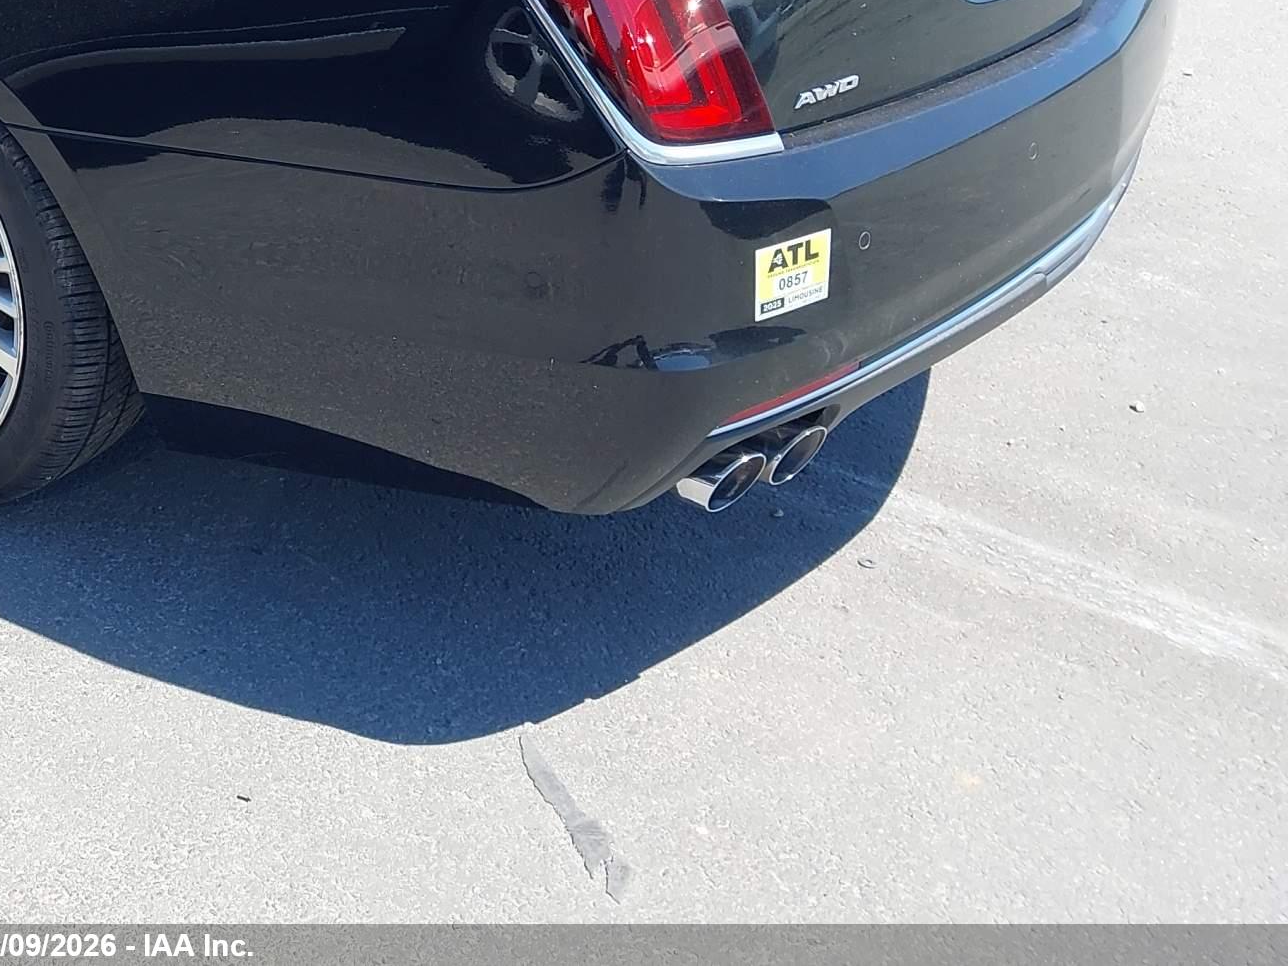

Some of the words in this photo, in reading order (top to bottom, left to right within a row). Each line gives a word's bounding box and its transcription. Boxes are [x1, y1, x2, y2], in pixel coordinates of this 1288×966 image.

[793, 75, 859, 109] AWD
[767, 239, 819, 273] ATL
[778, 271, 808, 291] 0857
